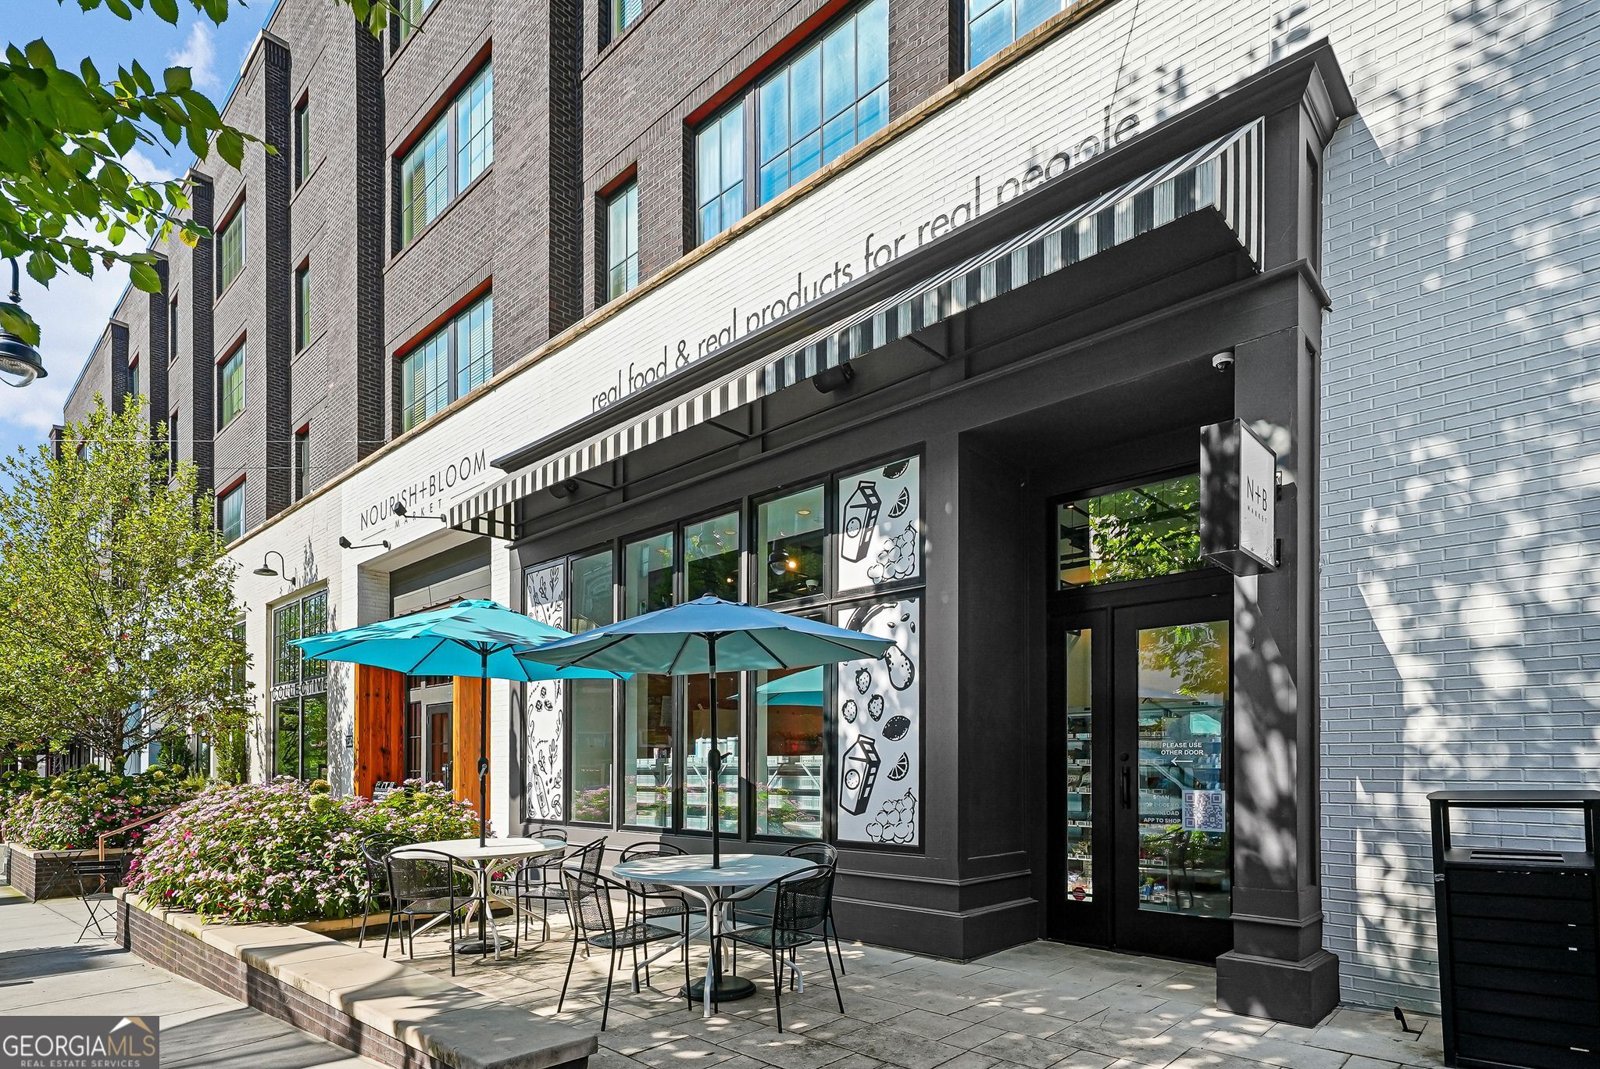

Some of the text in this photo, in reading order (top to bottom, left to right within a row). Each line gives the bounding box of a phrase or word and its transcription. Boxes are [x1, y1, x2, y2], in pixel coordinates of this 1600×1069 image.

[592, 369, 622, 413] real
[628, 345, 667, 394] food
[675, 339, 690, 370] &
[698, 307, 737, 359] real
[746, 272, 853, 335] products
[864, 233, 906, 273] for
[918, 175, 980, 246] real
[1246, 475, 1268, 512] N+B
[395, 499, 443, 528] MARKET
